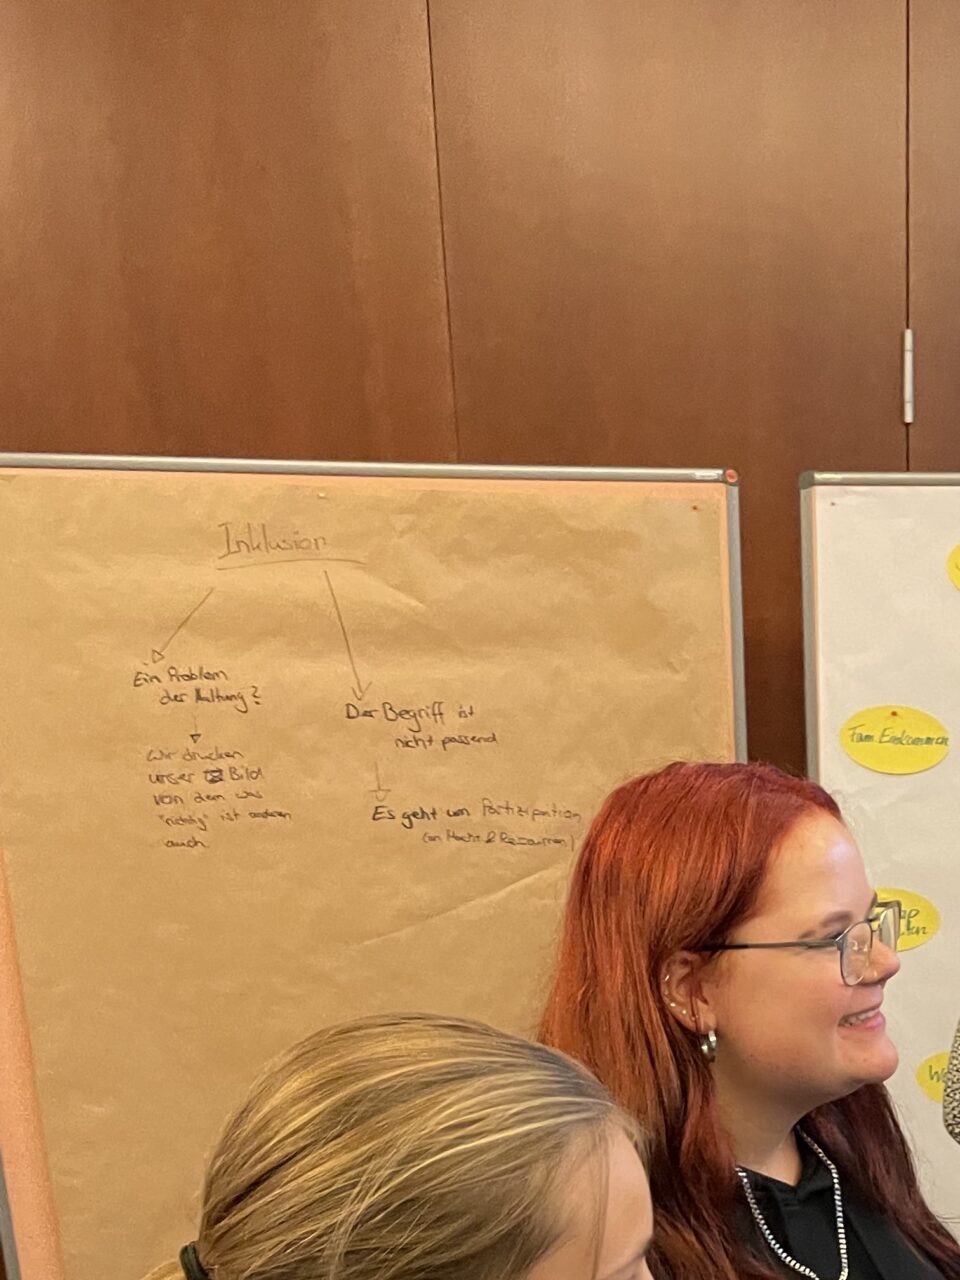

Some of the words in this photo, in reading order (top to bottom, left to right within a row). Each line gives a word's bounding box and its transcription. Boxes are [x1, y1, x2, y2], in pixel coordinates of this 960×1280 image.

[217, 521, 328, 560] Inklusion
[132, 663, 163, 688] Ein
[167, 665, 229, 683] Problem
[159, 693, 189, 706] der
[345, 702, 380, 720] Der
[382, 701, 446, 733] Begriff
[458, 704, 476, 719] ist
[394, 735, 434, 750] nicht
[442, 732, 499, 751] passend
[146, 749, 177, 762] Wir
[148, 772, 196, 785] unser
[228, 766, 264, 782] Bild
[153, 794, 185, 806] von
[193, 791, 226, 804] dem
[220, 808, 241, 822] ist
[372, 805, 397, 822] Es
[402, 806, 438, 829] geht
[446, 807, 471, 818] um
[164, 836, 209, 849] auch
